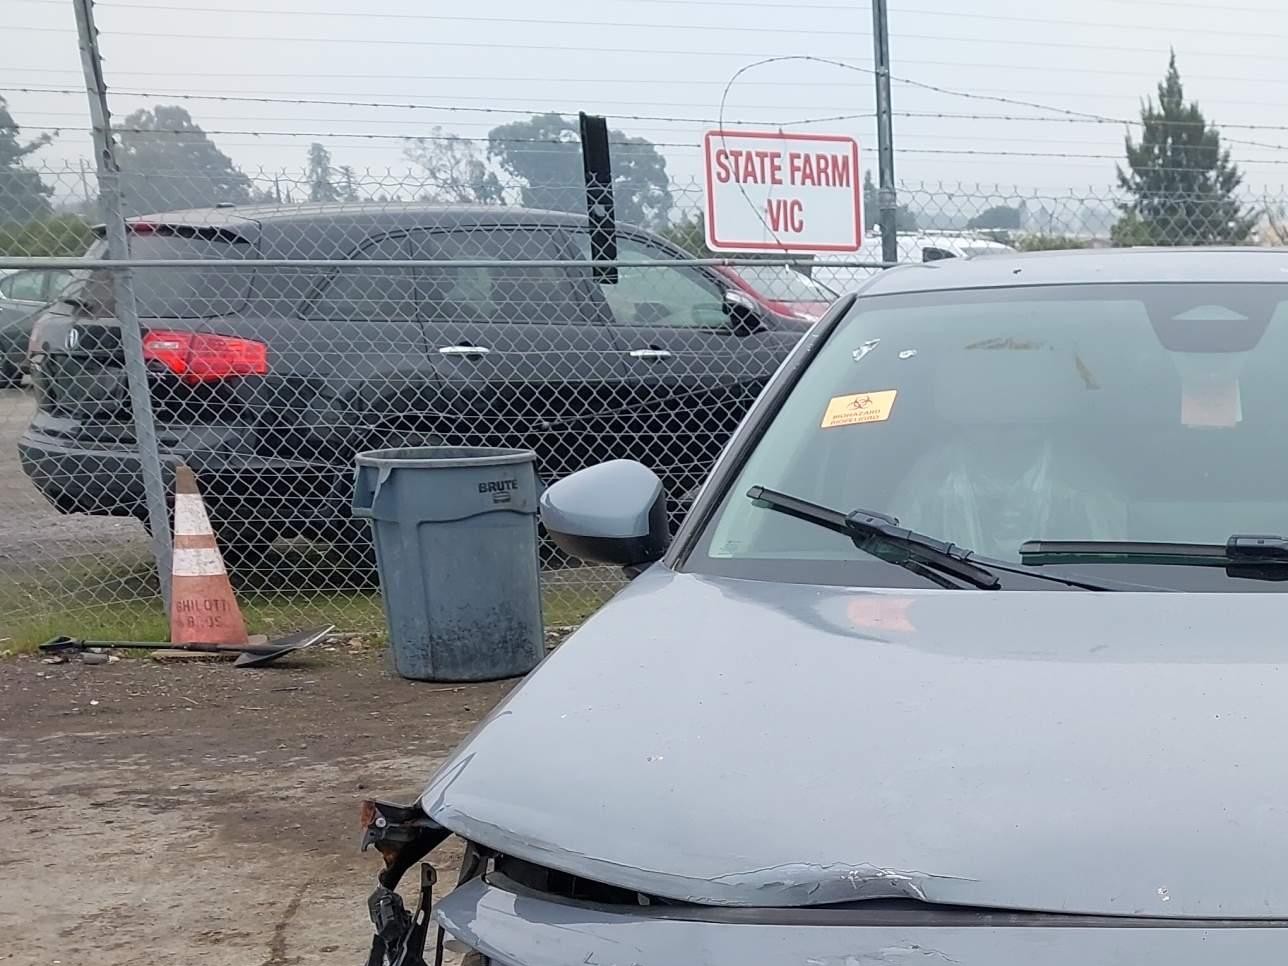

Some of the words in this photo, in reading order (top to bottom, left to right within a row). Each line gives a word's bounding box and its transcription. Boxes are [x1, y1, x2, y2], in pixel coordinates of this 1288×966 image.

[715, 149, 783, 185] STATE
[789, 152, 851, 188] FARM
[767, 198, 804, 233] VIC
[479, 480, 518, 493] BRUTE
